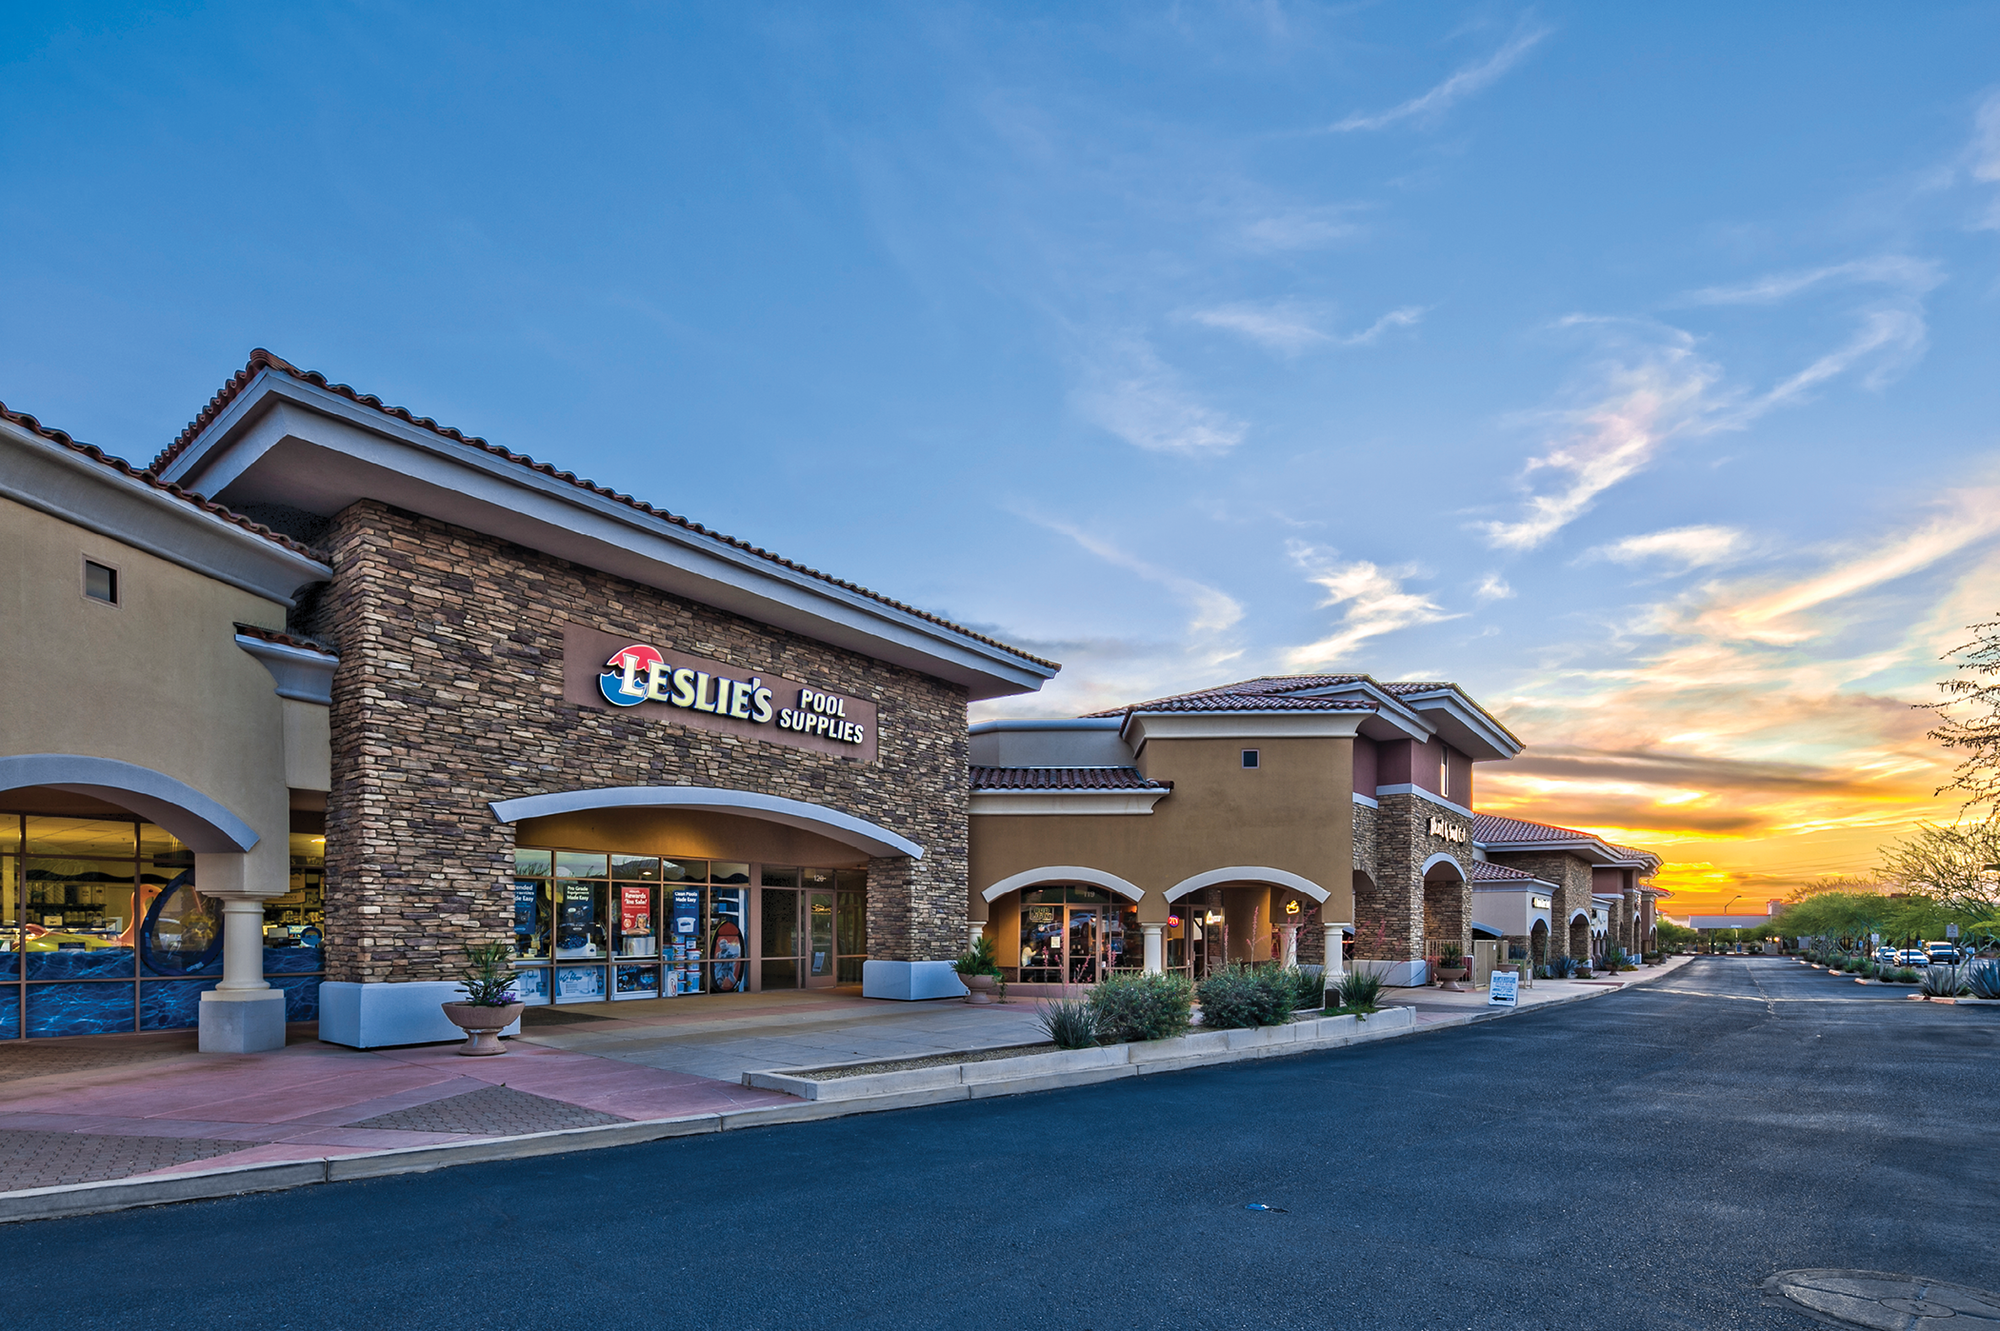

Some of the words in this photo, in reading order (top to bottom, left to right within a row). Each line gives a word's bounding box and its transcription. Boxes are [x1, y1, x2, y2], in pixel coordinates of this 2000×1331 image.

[619, 652, 774, 724] LESLIE'S
[799, 688, 847, 718] POOL
[779, 707, 865, 744] SUPPLIES
